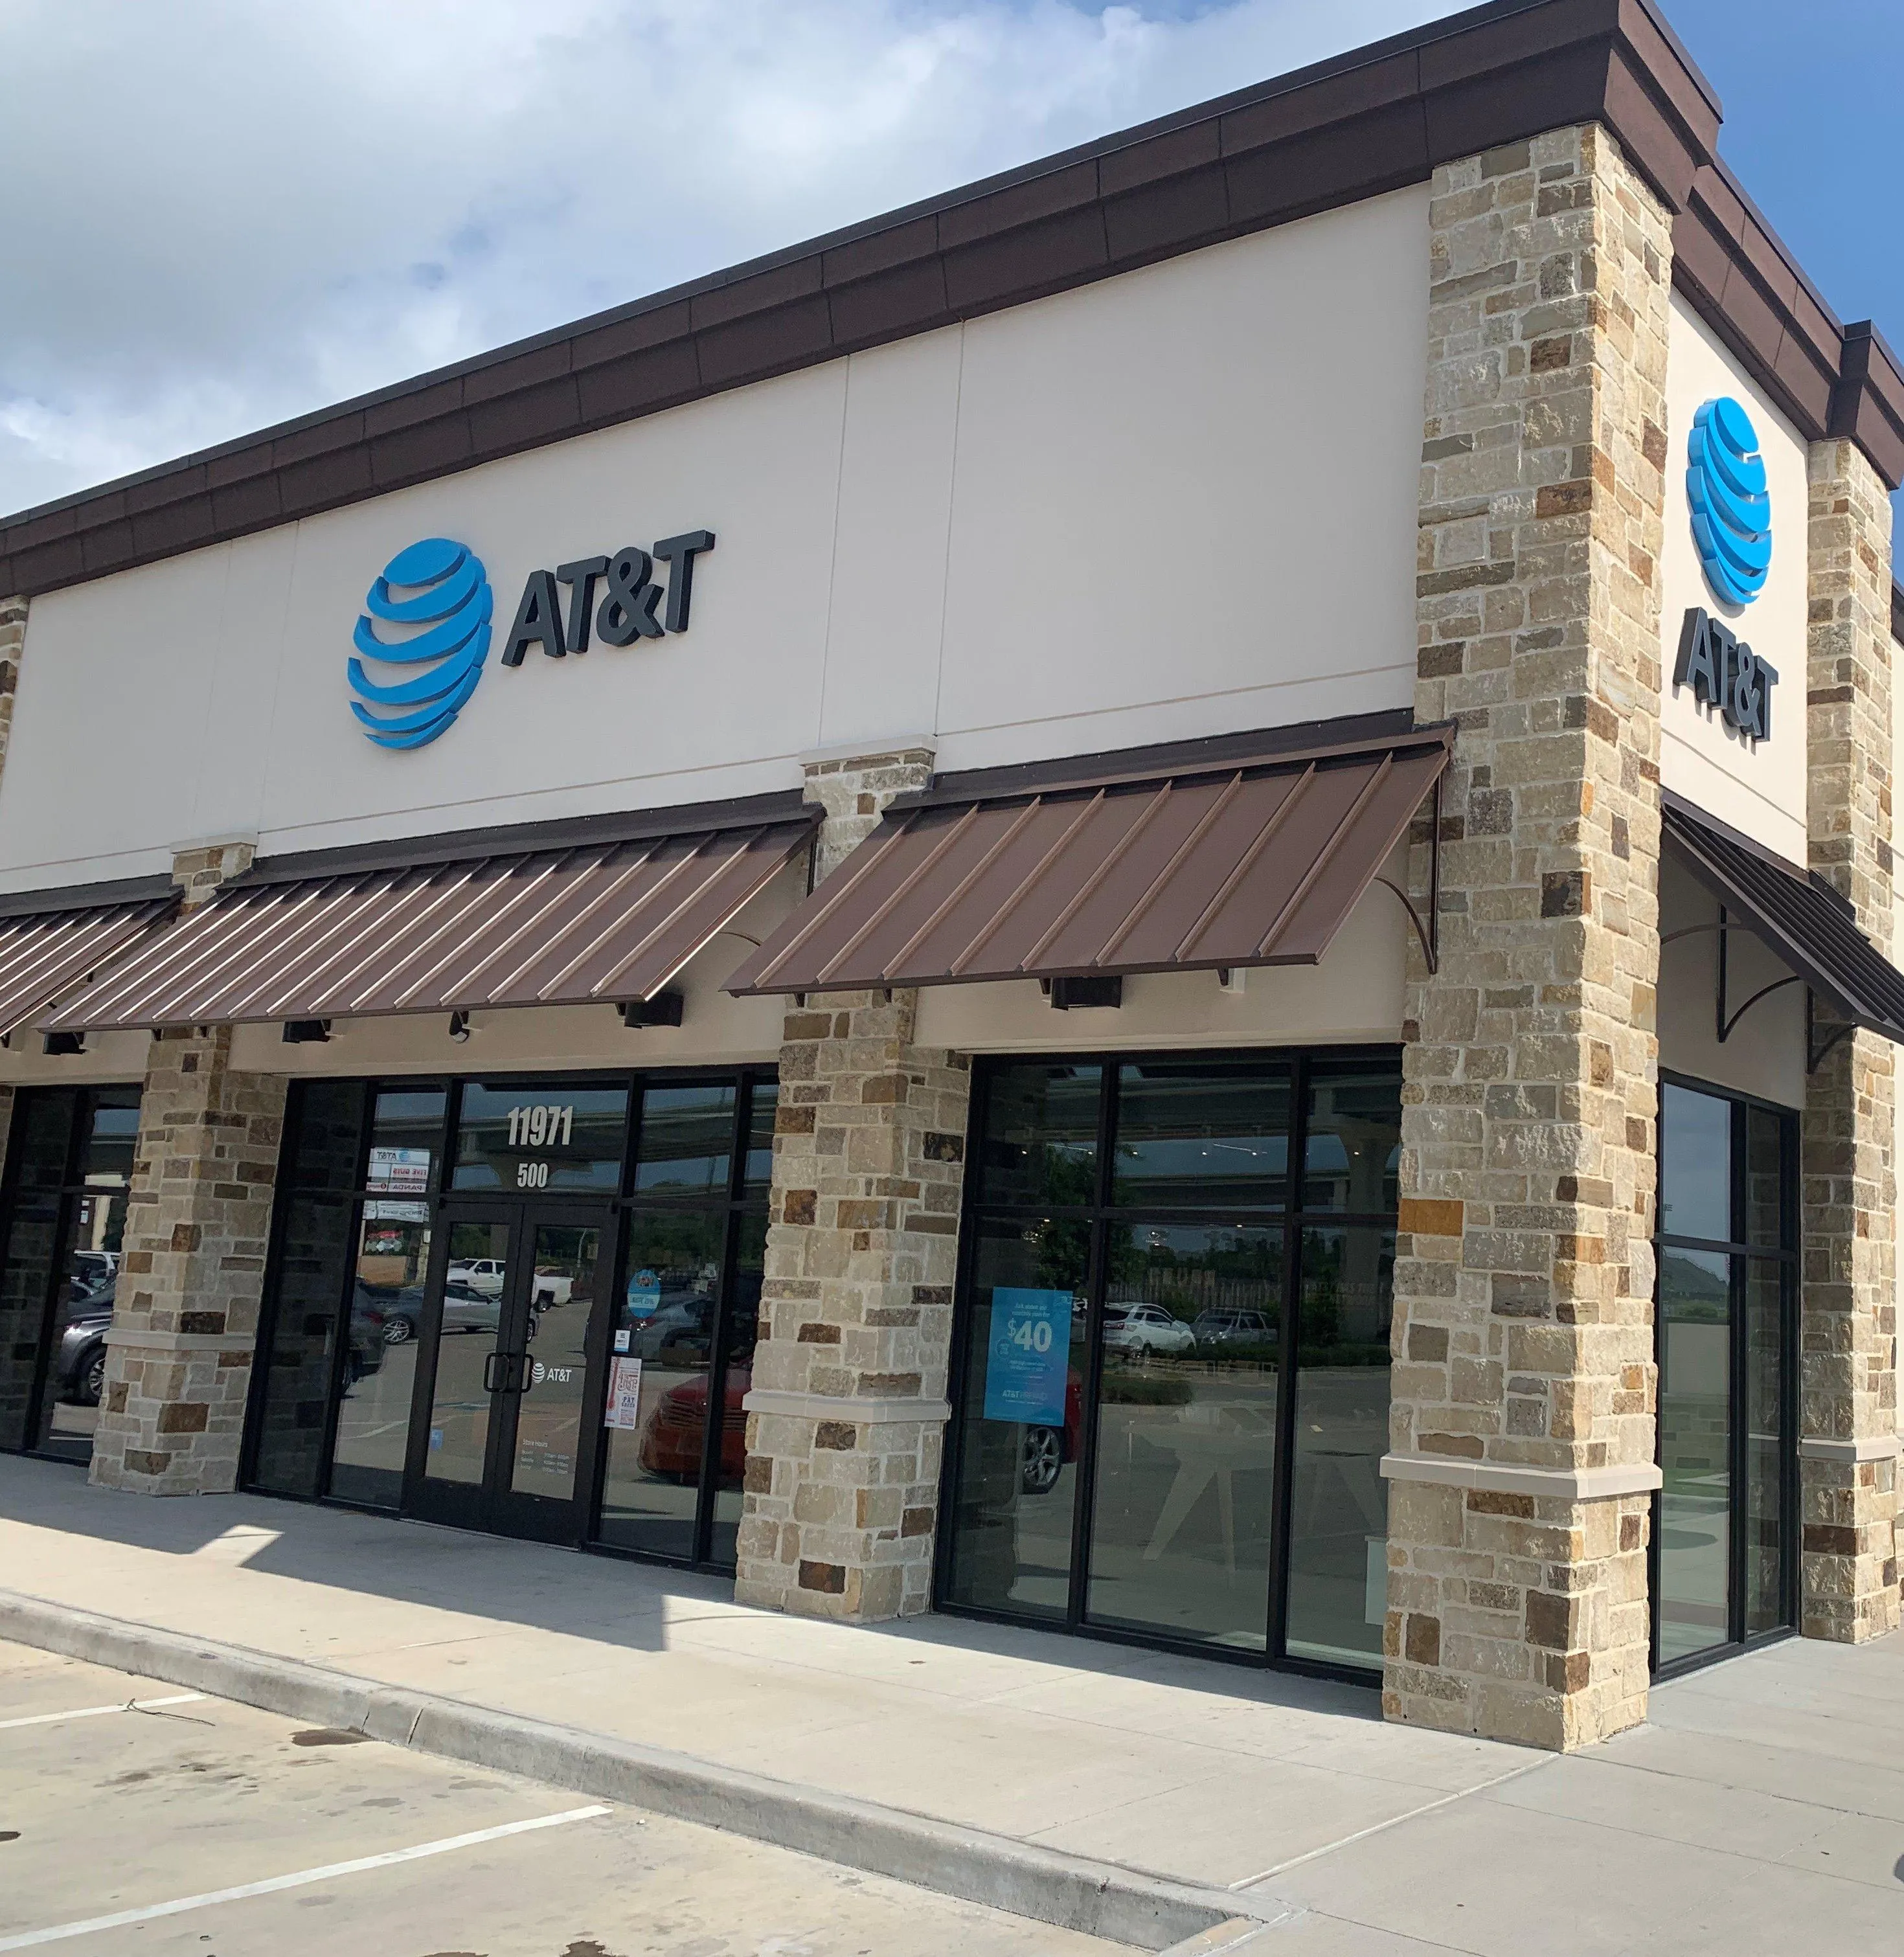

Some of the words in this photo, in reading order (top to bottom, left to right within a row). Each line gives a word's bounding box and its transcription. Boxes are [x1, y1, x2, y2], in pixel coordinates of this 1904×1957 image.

[501, 529, 716, 667] AT&T
[1672, 606, 1779, 743] AT&T
[507, 1105, 573, 1146] 11971
[517, 1162, 549, 1188] 500
[1007, 1318, 1052, 1353] $40
[547, 1368, 572, 1383] AT&T
